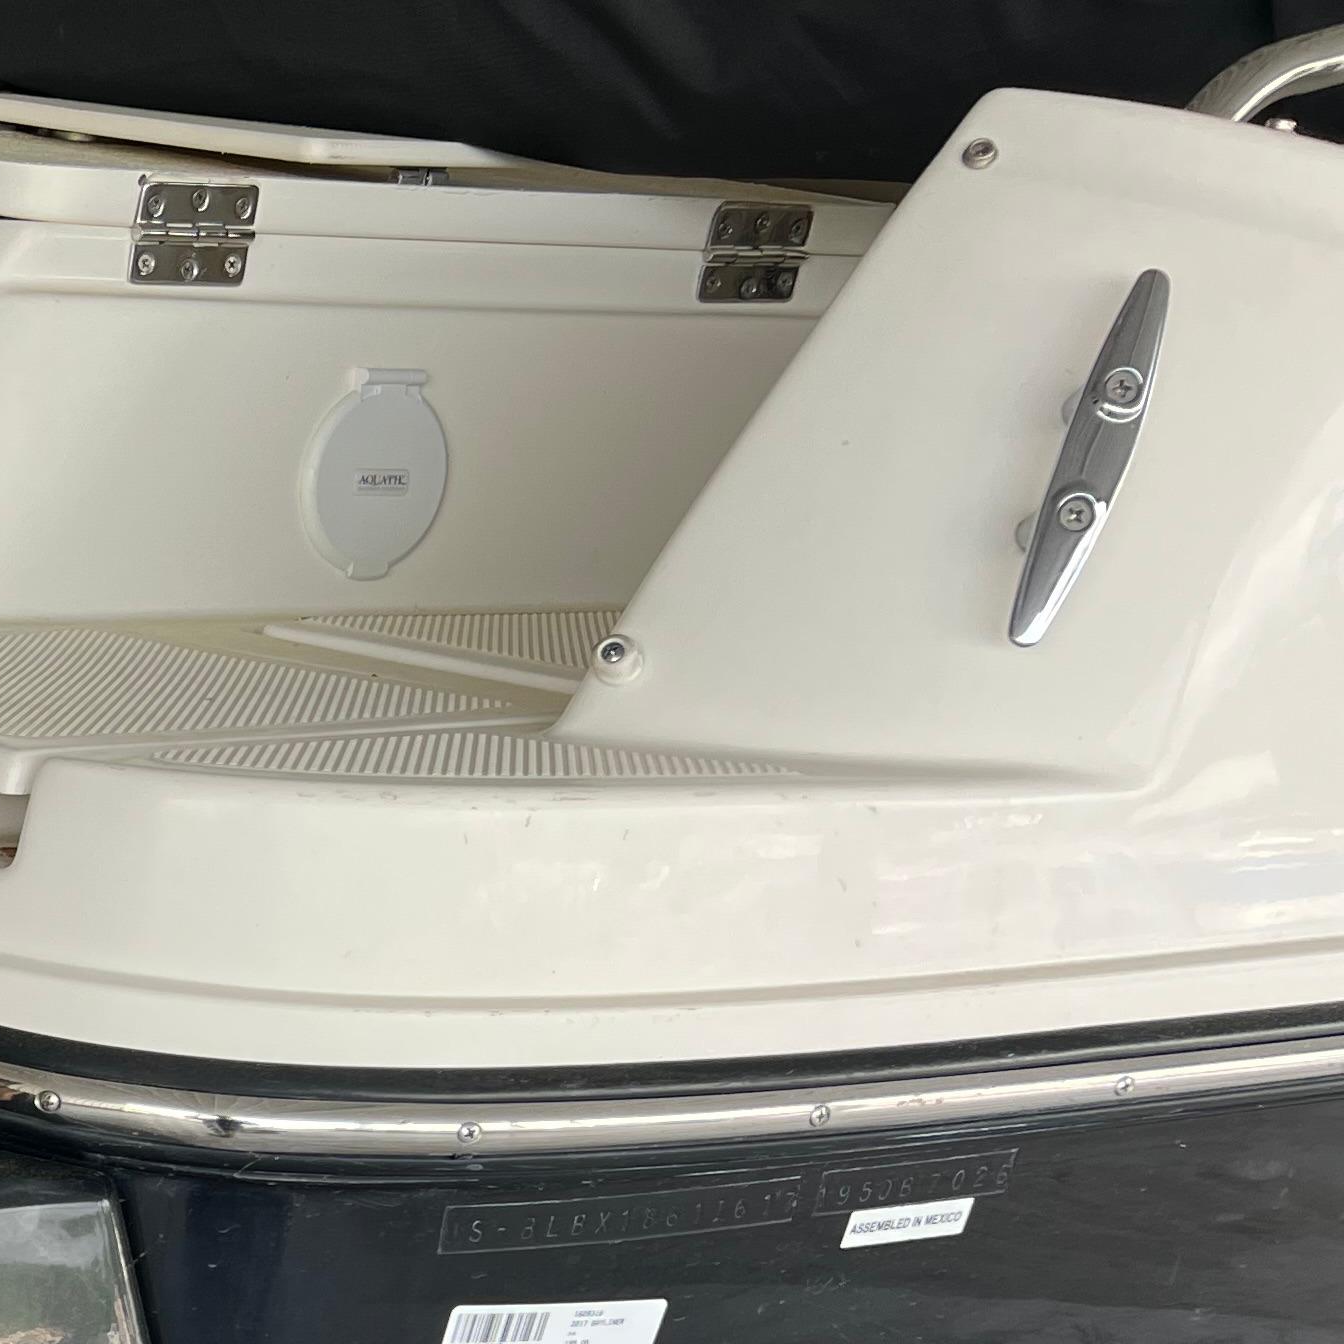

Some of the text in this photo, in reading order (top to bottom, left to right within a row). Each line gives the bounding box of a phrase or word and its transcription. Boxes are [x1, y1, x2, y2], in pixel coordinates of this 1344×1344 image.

[850, 1211, 963, 1234] ASSEMBLED IN MEXICO
